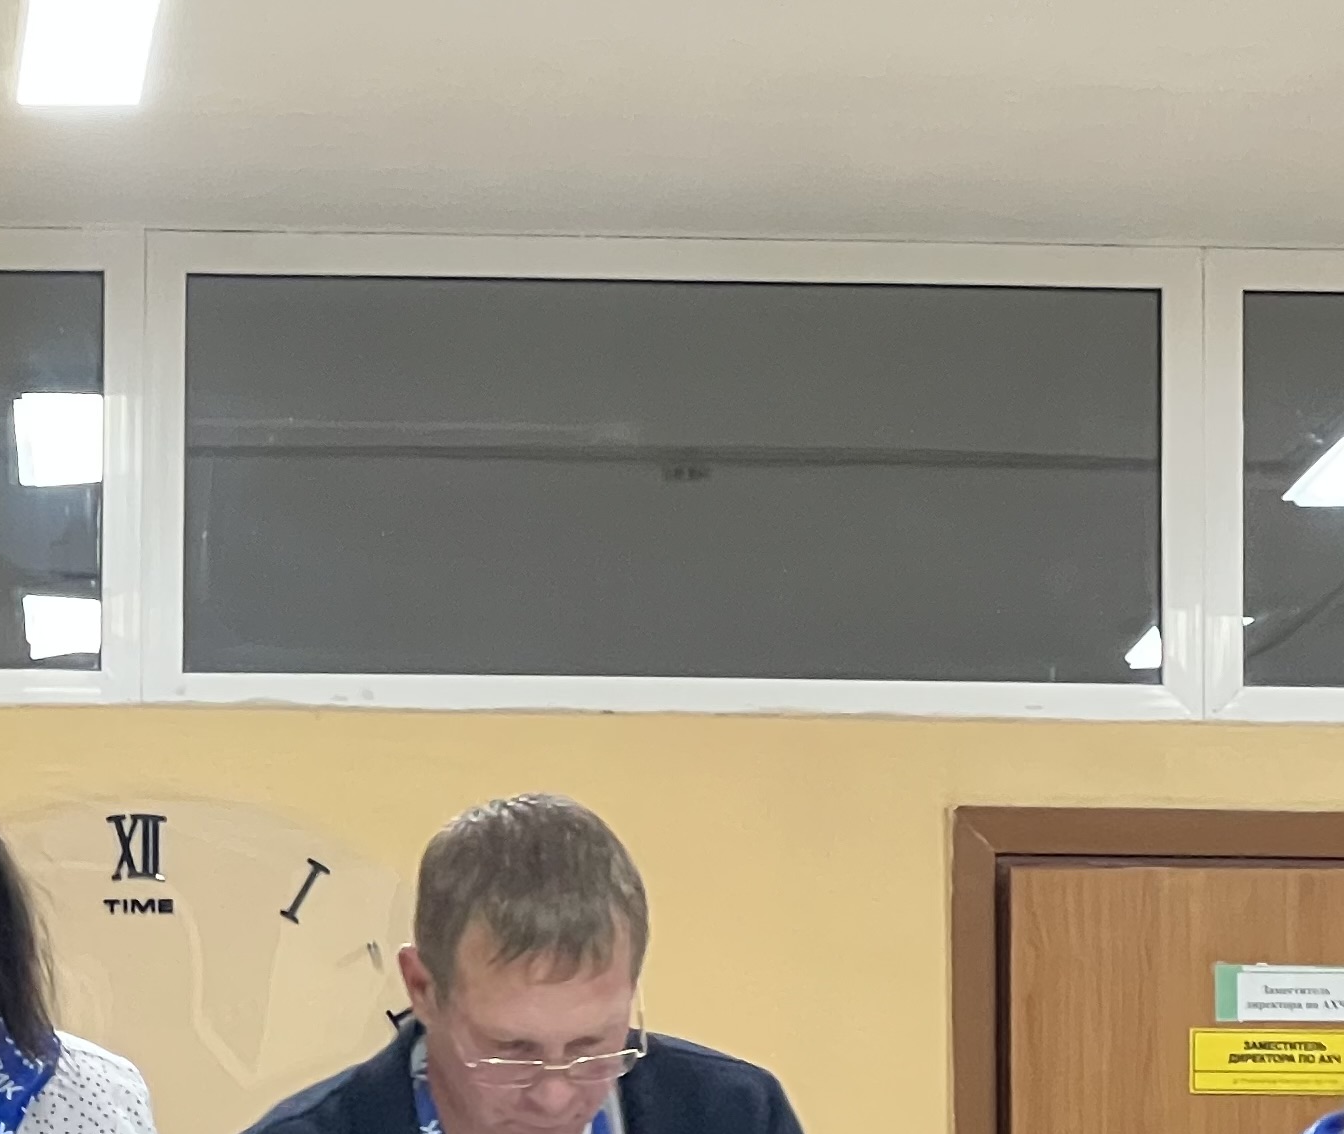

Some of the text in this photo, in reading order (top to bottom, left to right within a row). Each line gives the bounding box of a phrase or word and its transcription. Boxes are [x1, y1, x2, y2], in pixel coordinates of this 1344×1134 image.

[106, 813, 168, 882] XII
[103, 898, 174, 914] TIME
[1263, 984, 1331, 996] Заместитель
[1243, 1040, 1327, 1051] ЗАМЕСТИТЕЛЬ
[1228, 1053, 1342, 1064] ДИРЕКТОРА ПО АХЧ
